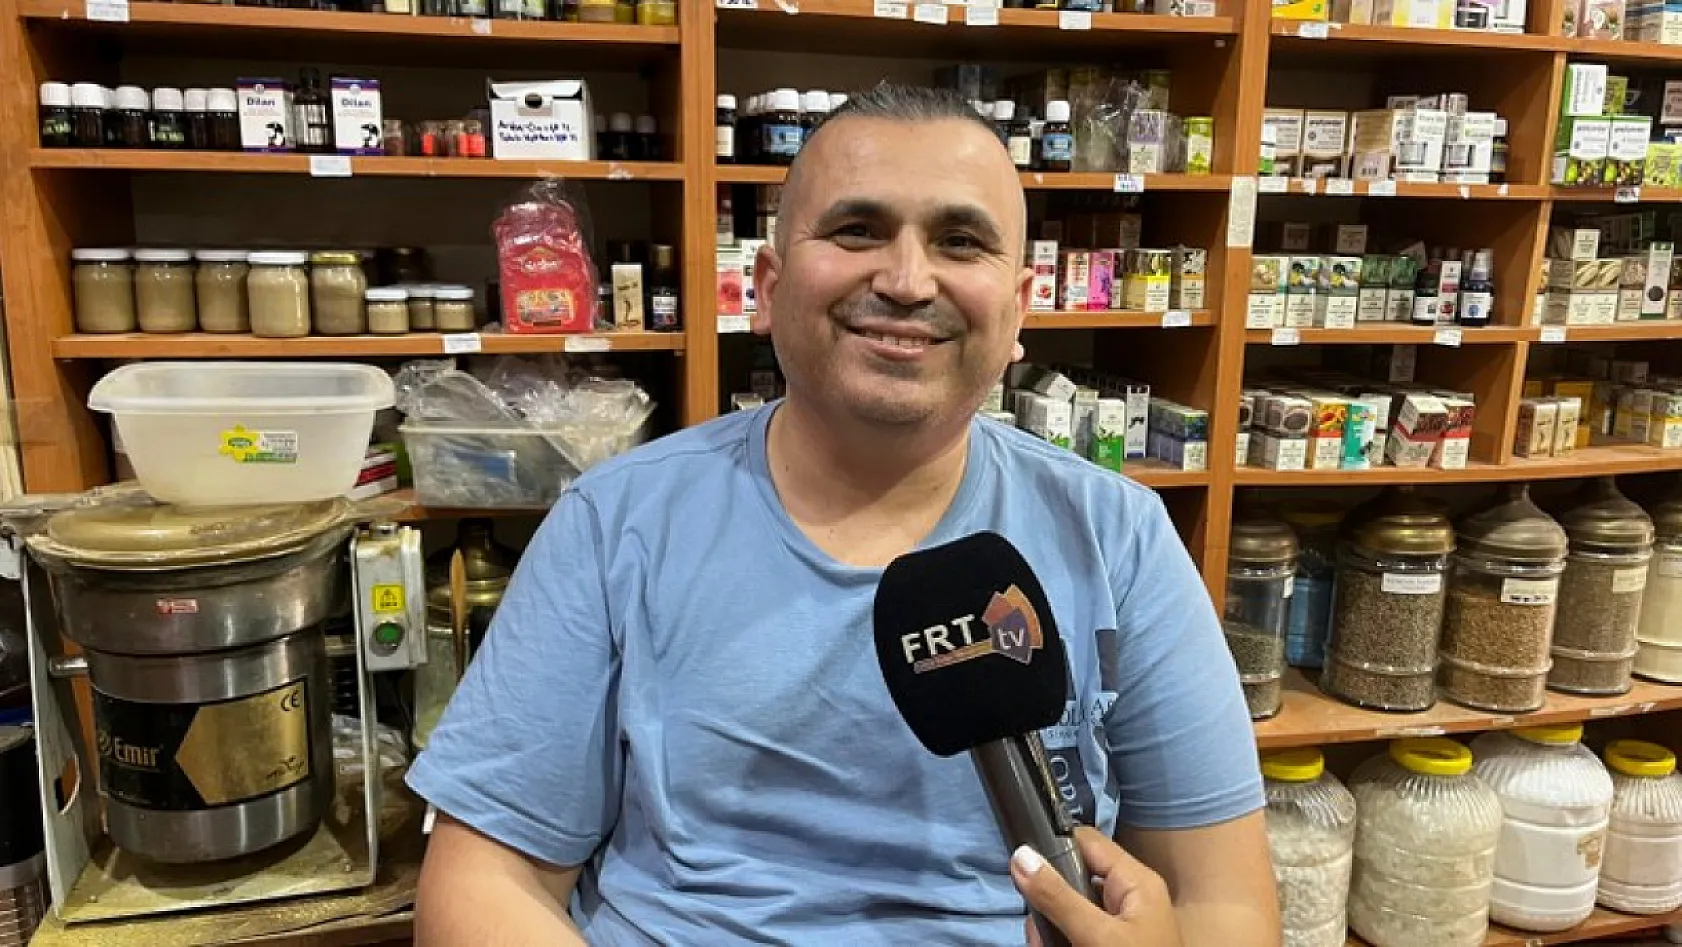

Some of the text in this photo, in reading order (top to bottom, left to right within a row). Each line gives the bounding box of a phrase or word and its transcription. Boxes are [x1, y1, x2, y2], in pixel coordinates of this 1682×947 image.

[246, 96, 276, 106] Dilan
[341, 98, 372, 107] Dilan
[901, 613, 1025, 664] FRT tv
[280, 689, 301, 712] CE
[114, 736, 160, 768] Emir
